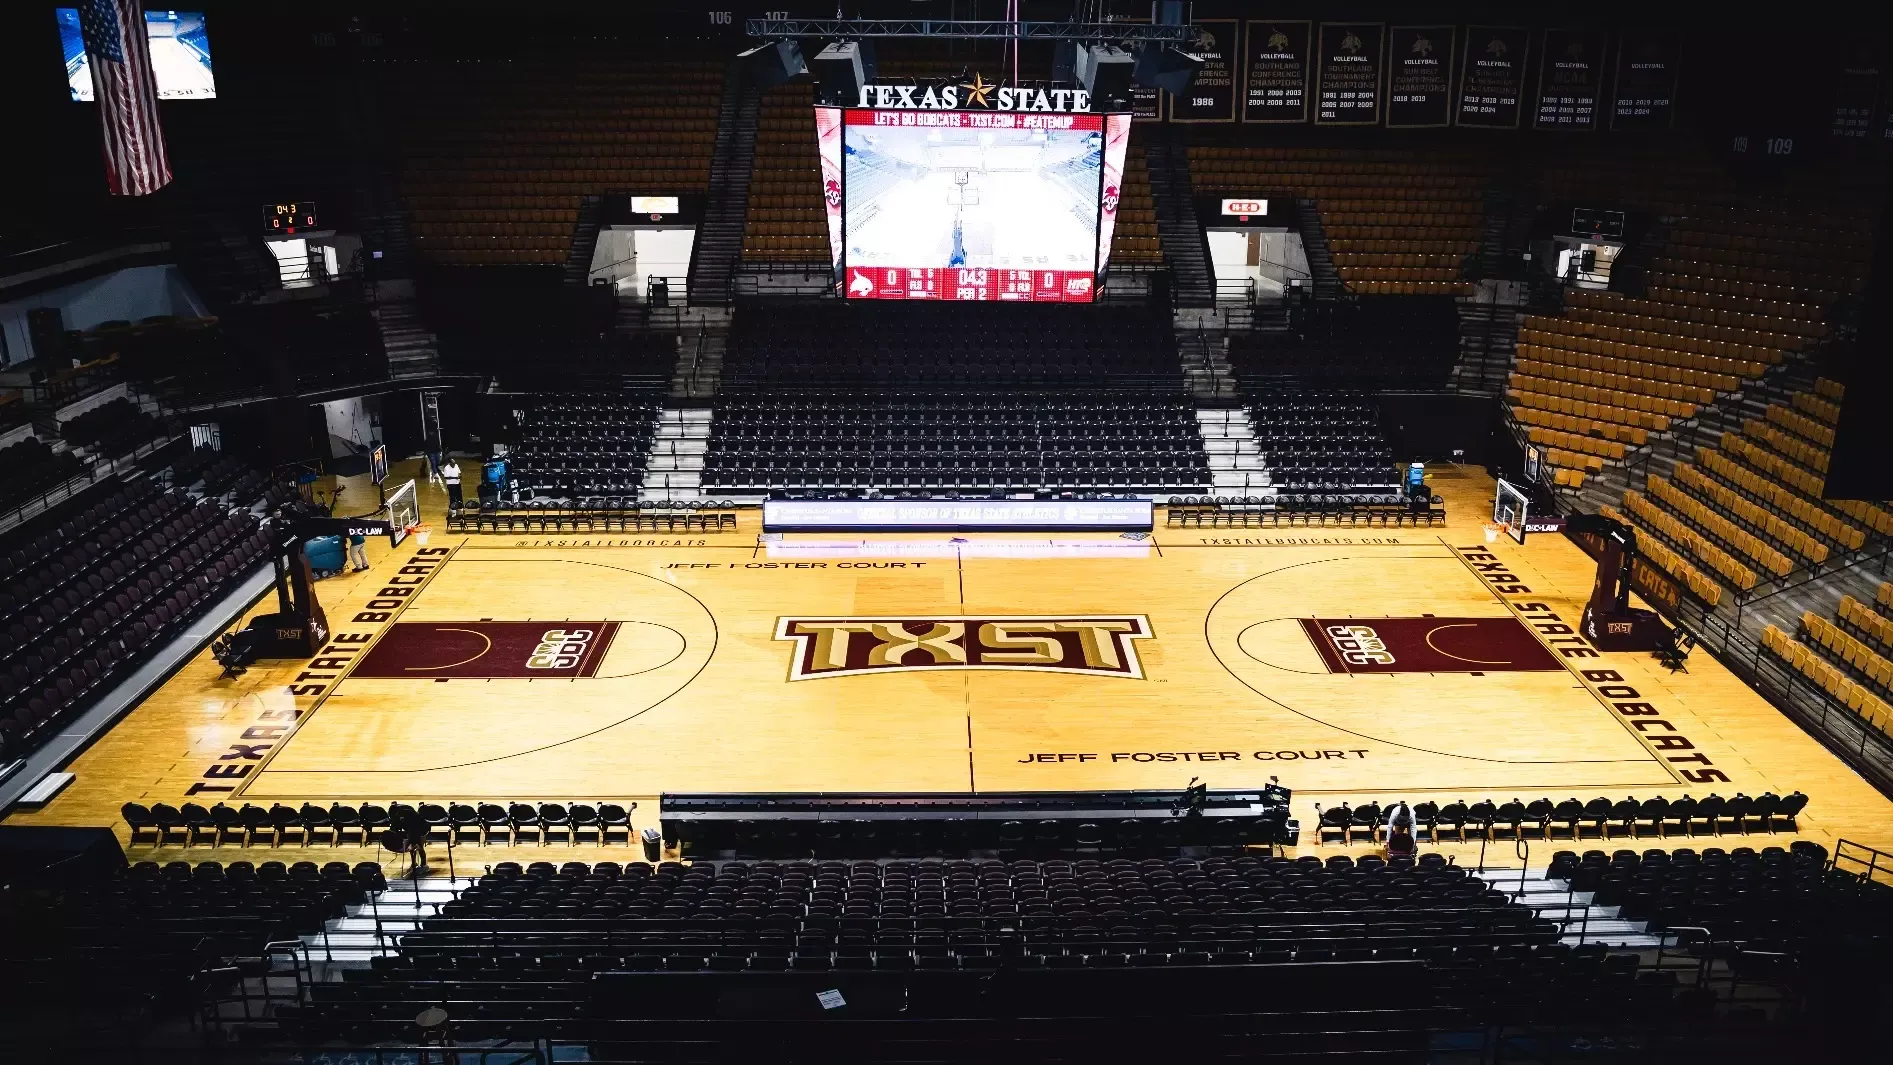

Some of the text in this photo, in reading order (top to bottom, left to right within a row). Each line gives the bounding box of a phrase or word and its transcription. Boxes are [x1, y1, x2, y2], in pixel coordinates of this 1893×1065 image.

[708, 11, 732, 25] 106
[1254, 62, 1300, 70] SOUTHLAND
[1327, 64, 1373, 72] SOUTHLAND
[1476, 60, 1512, 68] VOLLEYBALL
[1252, 70, 1301, 78] CONFERENCE
[1323, 72, 1376, 80] TOURNAMENT
[1249, 79, 1303, 87] CHAMPIONS
[1322, 81, 1376, 89] CHAMPIONS
[1393, 84, 1446, 92] CHAMPIONS
[857, 85, 1091, 114] TEXAS STATE
[1192, 97, 1214, 107] 1986
[873, 111, 901, 126] LET'S
[901, 112, 915, 127] GO
[915, 112, 960, 128] BOBCATS
[967, 113, 1016, 128] TXST.COM
[1022, 114, 1074, 130] #EATEMUP
[1733, 135, 1748, 153] 109
[1766, 137, 1793, 155] 109
[272, 218, 280, 228] 0
[306, 216, 314, 225] 0
[886, 270, 897, 287] 0
[1043, 272, 1053, 289] 0
[957, 287, 987, 301] PER 2
[982, 507, 1010, 520] STATE
[728, 561, 829, 570] FOSTER
[836, 561, 928, 570] COURT
[275, 628, 304, 641] TXST
[1607, 621, 1634, 635] TXST
[784, 617, 1143, 677] TXST
[184, 546, 450, 796] TEXAS STATE BOBCATS
[1458, 545, 1532, 595] TEXAS
[1513, 601, 1602, 660] STATE
[1582, 668, 1732, 785] BOBCATS
[1016, 748, 1369, 764] JEFF FOSTER COURT
